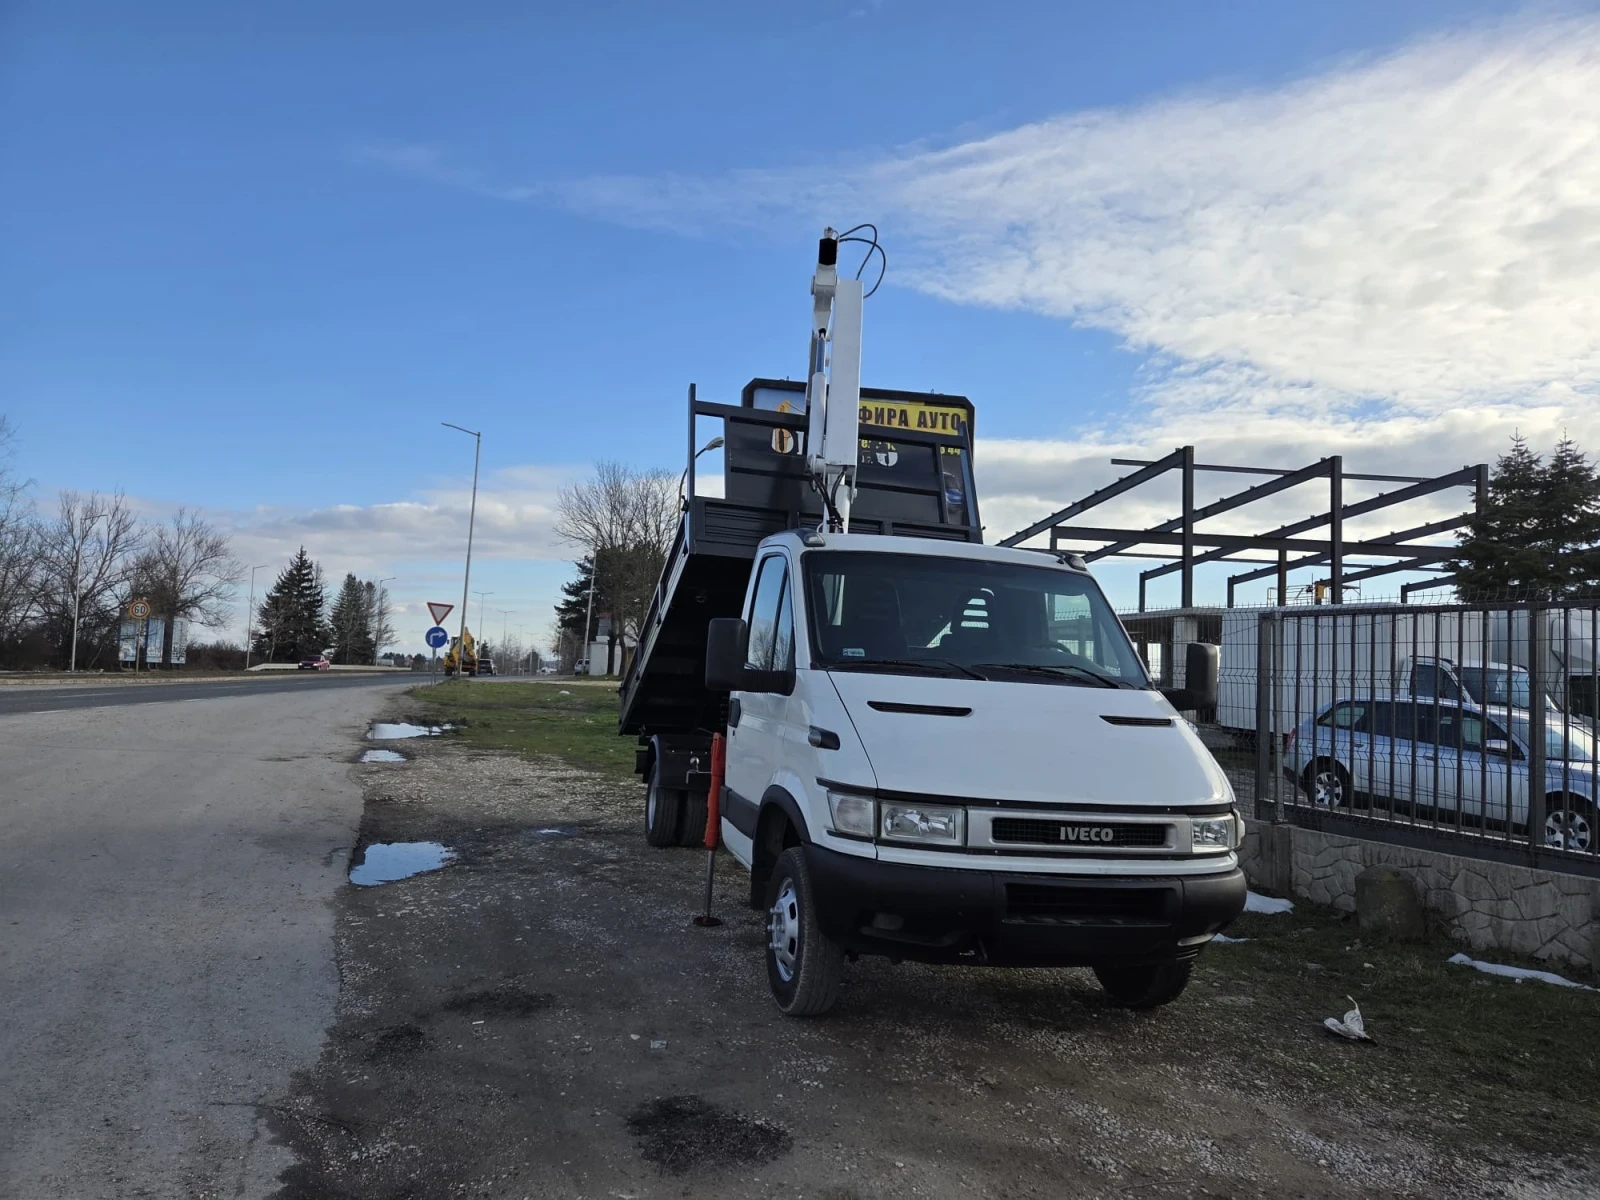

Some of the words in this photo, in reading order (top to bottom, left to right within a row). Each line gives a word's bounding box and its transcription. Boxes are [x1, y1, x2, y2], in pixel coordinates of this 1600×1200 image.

[917, 411, 961, 431] АУТО
[134, 605, 146, 614] 60
[1060, 826, 1114, 842] IVECO
